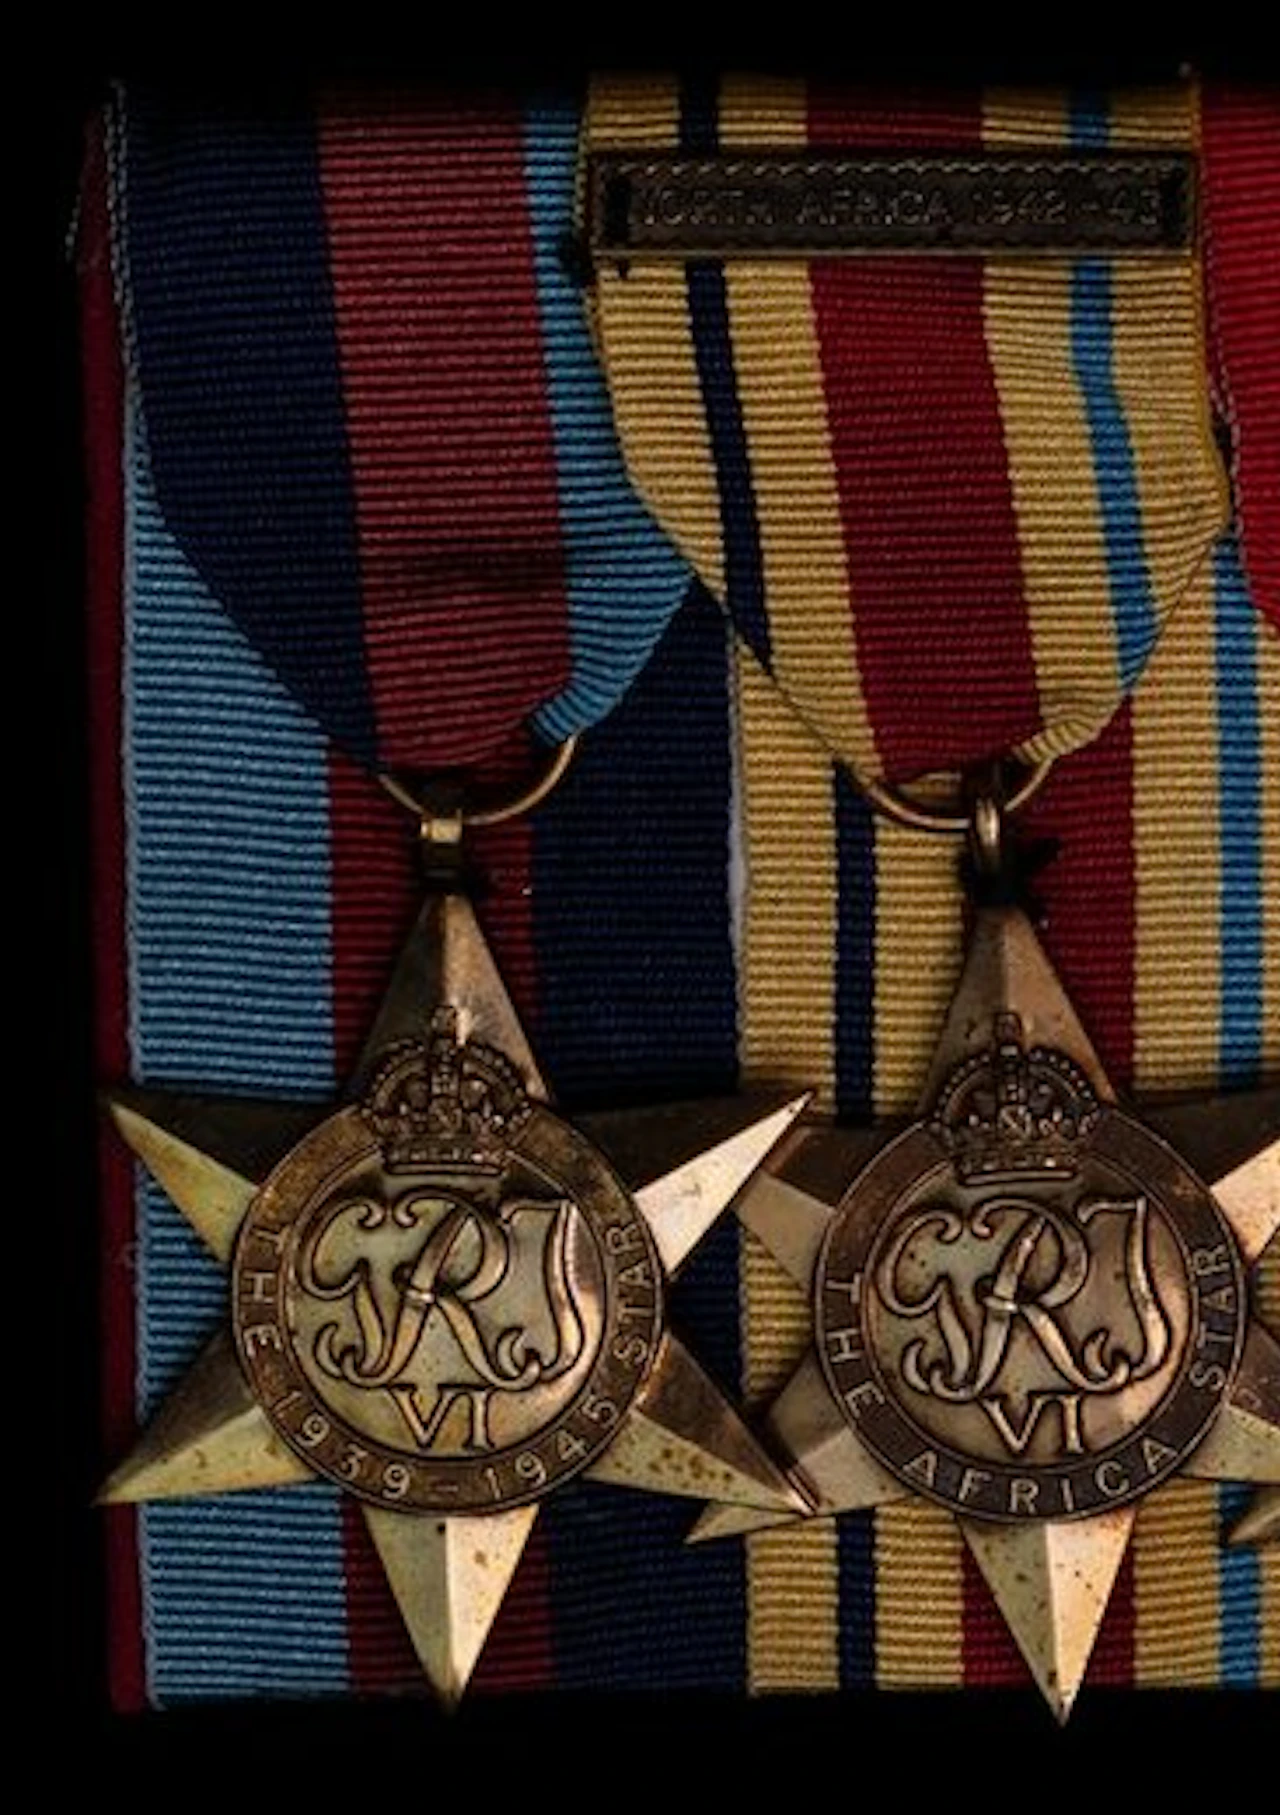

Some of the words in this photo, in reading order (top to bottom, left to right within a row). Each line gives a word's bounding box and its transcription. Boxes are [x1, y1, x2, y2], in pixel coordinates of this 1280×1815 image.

[242, 1220, 291, 1359] THE
[605, 1220, 657, 1364] STAR
[388, 1381, 498, 1450] VI
[825, 1272, 886, 1419] THE
[902, 1436, 1180, 1515] AFRICA
[1189, 1242, 1237, 1393] STAR
[974, 1390, 1086, 1456] VI
